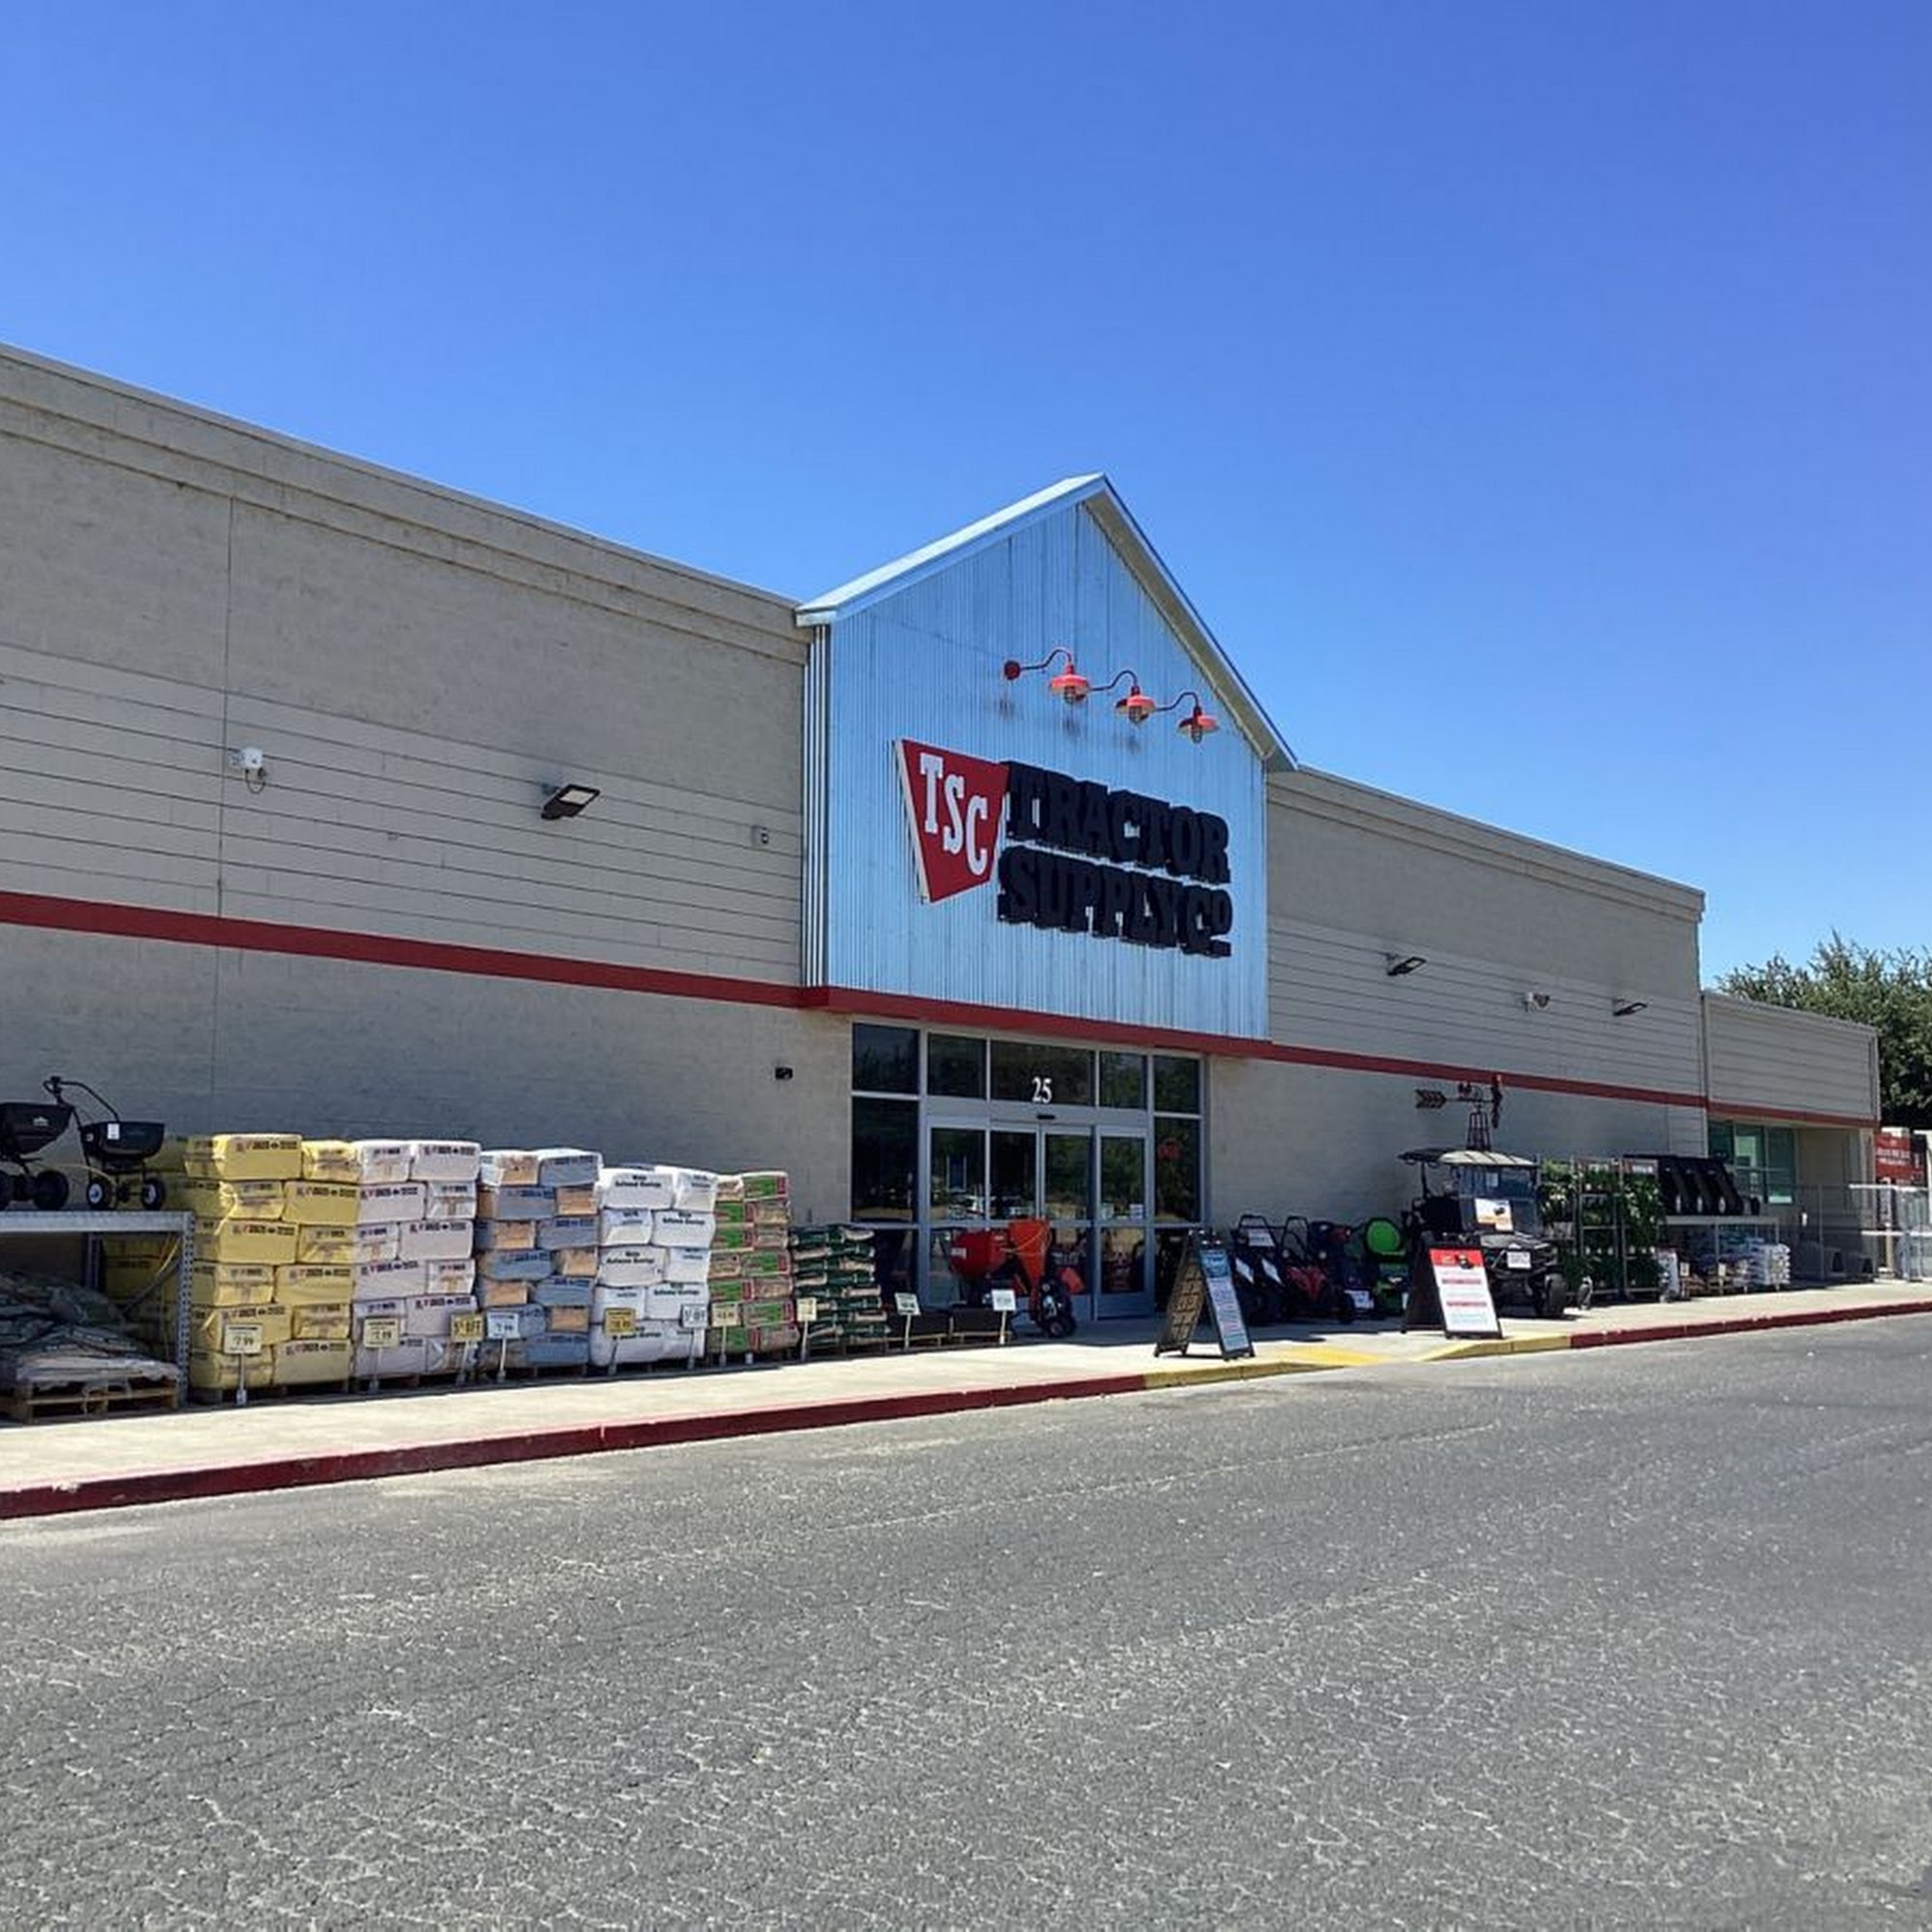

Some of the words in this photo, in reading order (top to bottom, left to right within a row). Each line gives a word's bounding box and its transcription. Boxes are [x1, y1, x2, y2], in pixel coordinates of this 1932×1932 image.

[920, 753, 988, 875] TSC
[1002, 760, 1231, 883] TRACTOR
[996, 846, 1179, 949] SUPPLY
[1032, 1076, 1053, 1103] 25
